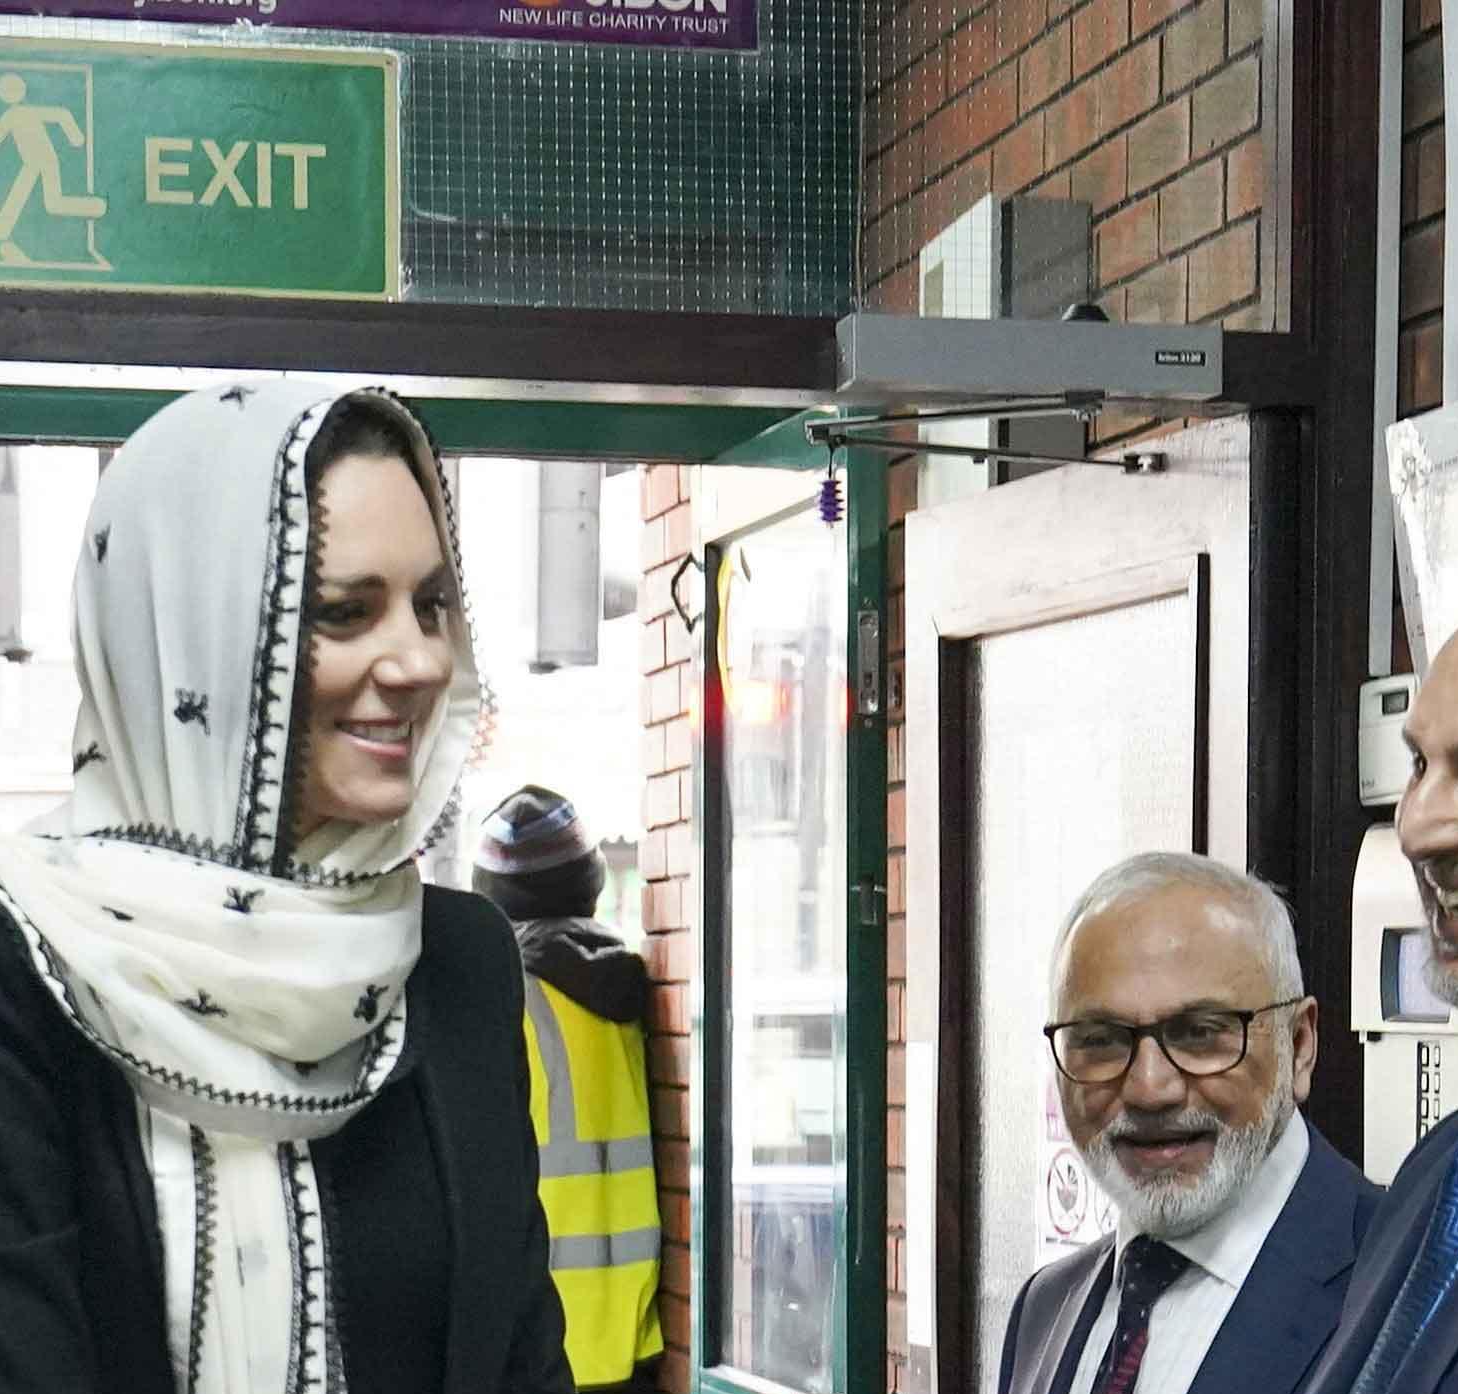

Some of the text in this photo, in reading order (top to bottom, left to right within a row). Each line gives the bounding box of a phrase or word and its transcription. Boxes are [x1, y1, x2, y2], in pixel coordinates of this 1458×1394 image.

[499, 8, 729, 35] NEW LIFE CHARITY TRUST
[145, 136, 326, 209] EXIT
